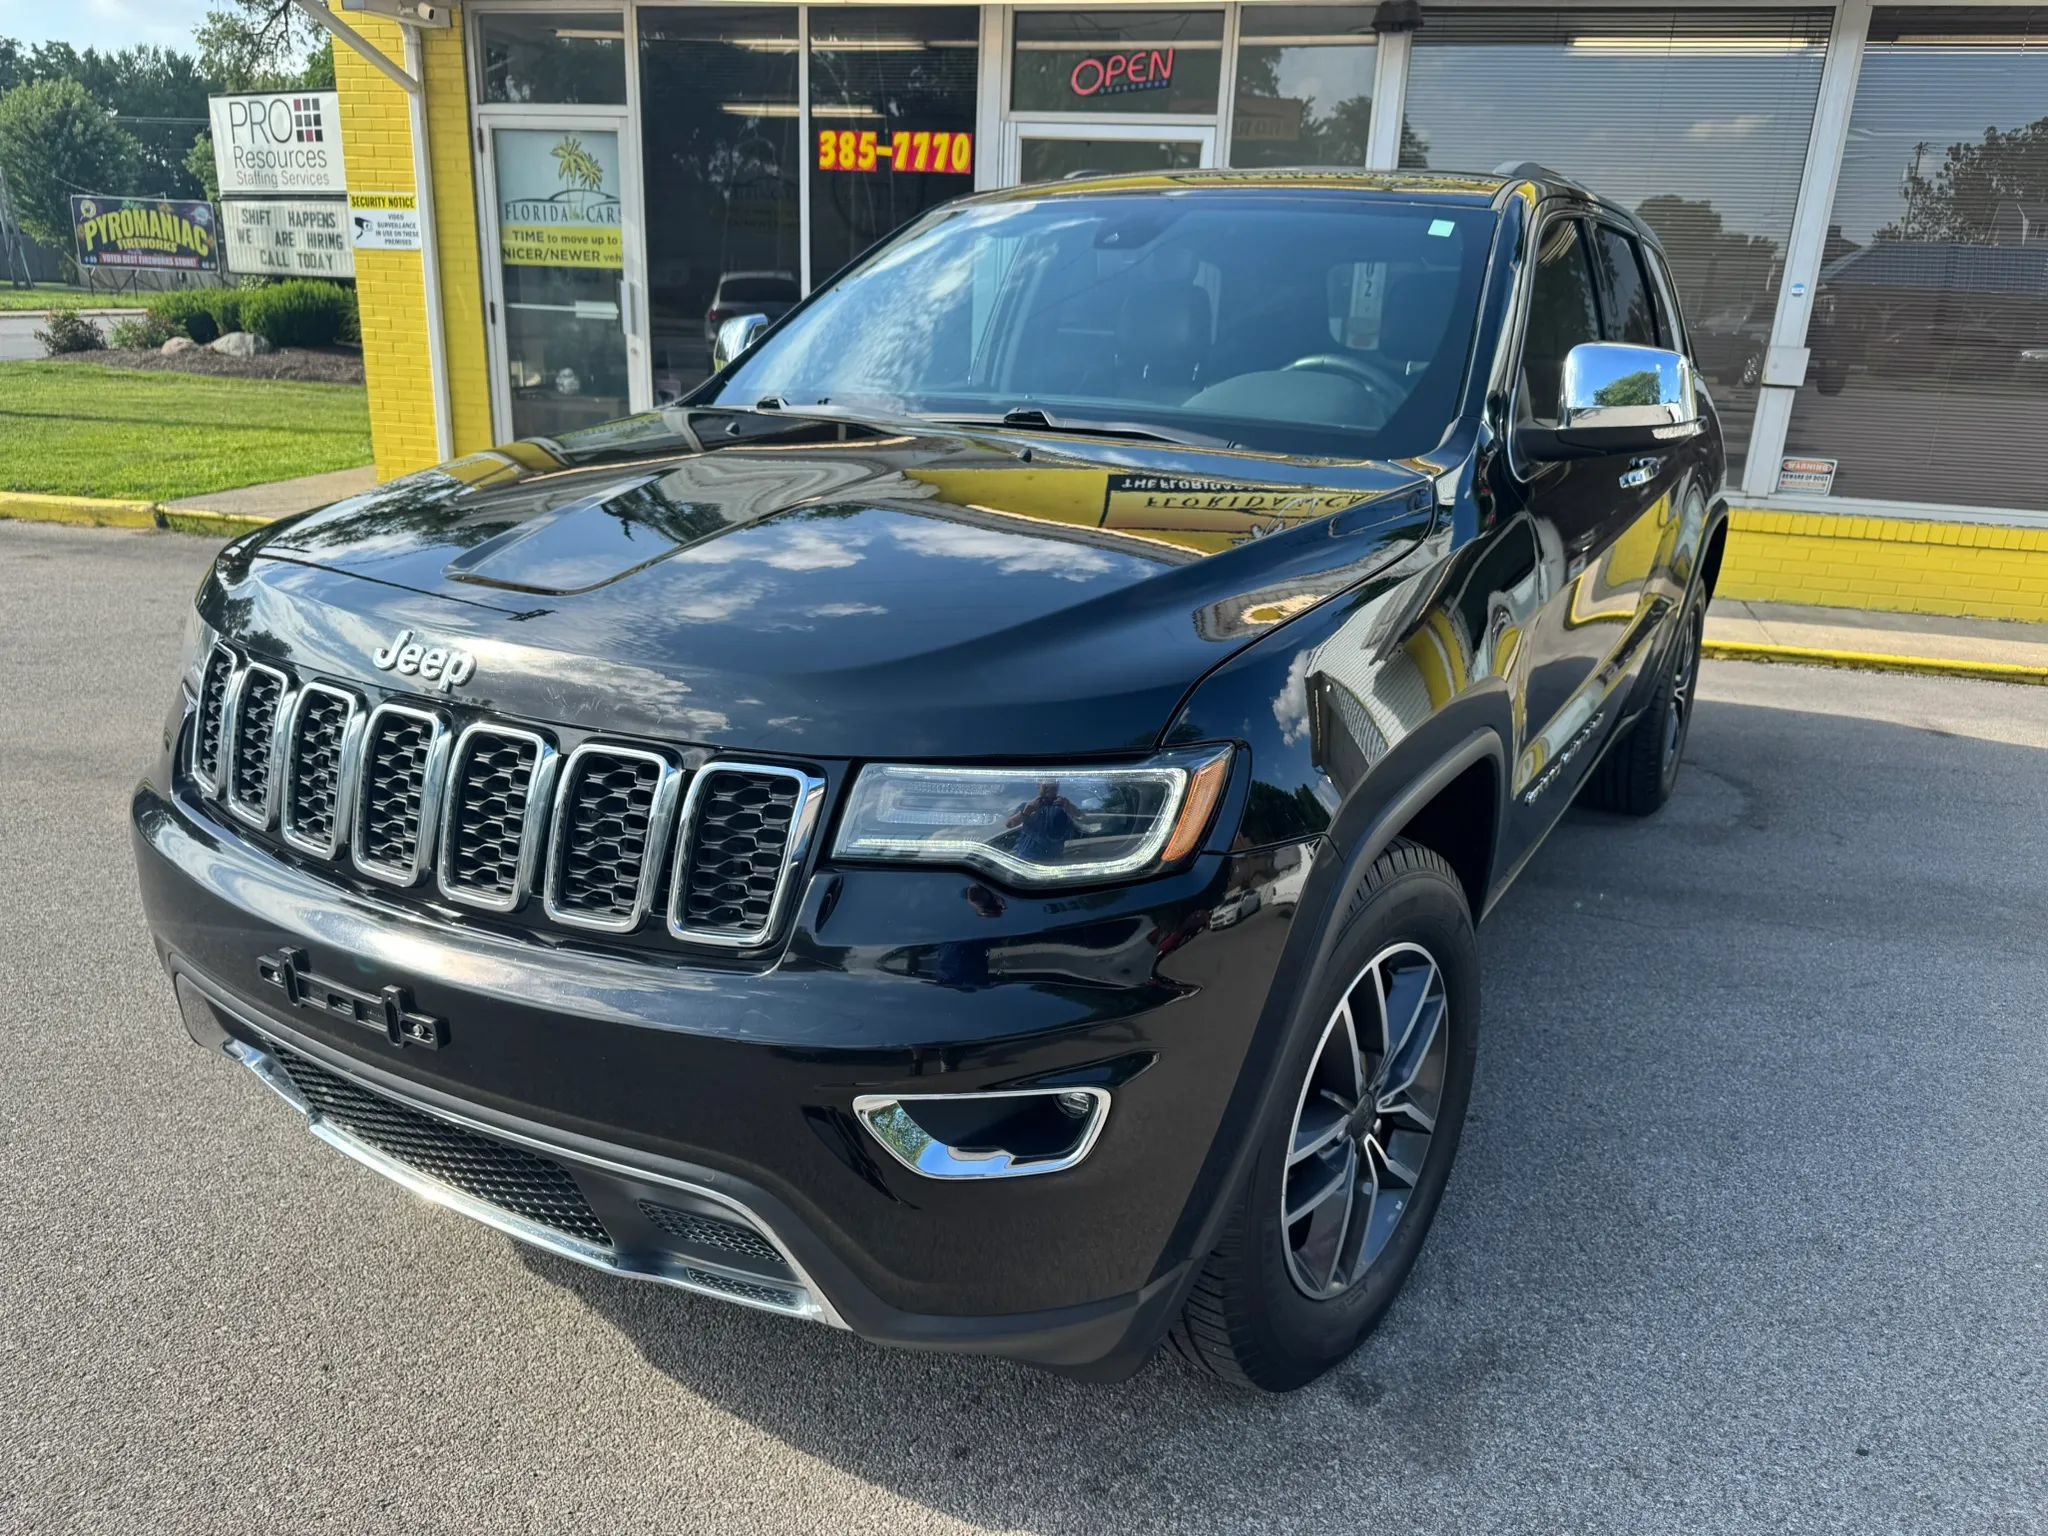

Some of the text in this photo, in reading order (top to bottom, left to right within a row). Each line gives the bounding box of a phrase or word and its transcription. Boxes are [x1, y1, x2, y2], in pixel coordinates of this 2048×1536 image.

[1071, 47, 1175, 97] OPEN
[229, 99, 293, 144] PRO
[233, 146, 328, 169] Resources
[818, 131, 972, 173] 385-7770
[236, 170, 330, 189] Staffing Services
[351, 195, 415, 209] SECURITY NOTICE
[504, 203, 569, 222] FLORIDA
[242, 208, 336, 228] SHIFT HAPPENS
[84, 208, 209, 257] PYROMANIAC
[236, 228, 344, 250] WE ARE HIRING
[512, 230, 618, 246] TIME to move up to
[116, 237, 178, 253] FIREWORKS
[502, 248, 600, 262] NICER/NEWER
[260, 249, 333, 271] CALL TODAY
[373, 629, 477, 694] Jeep
